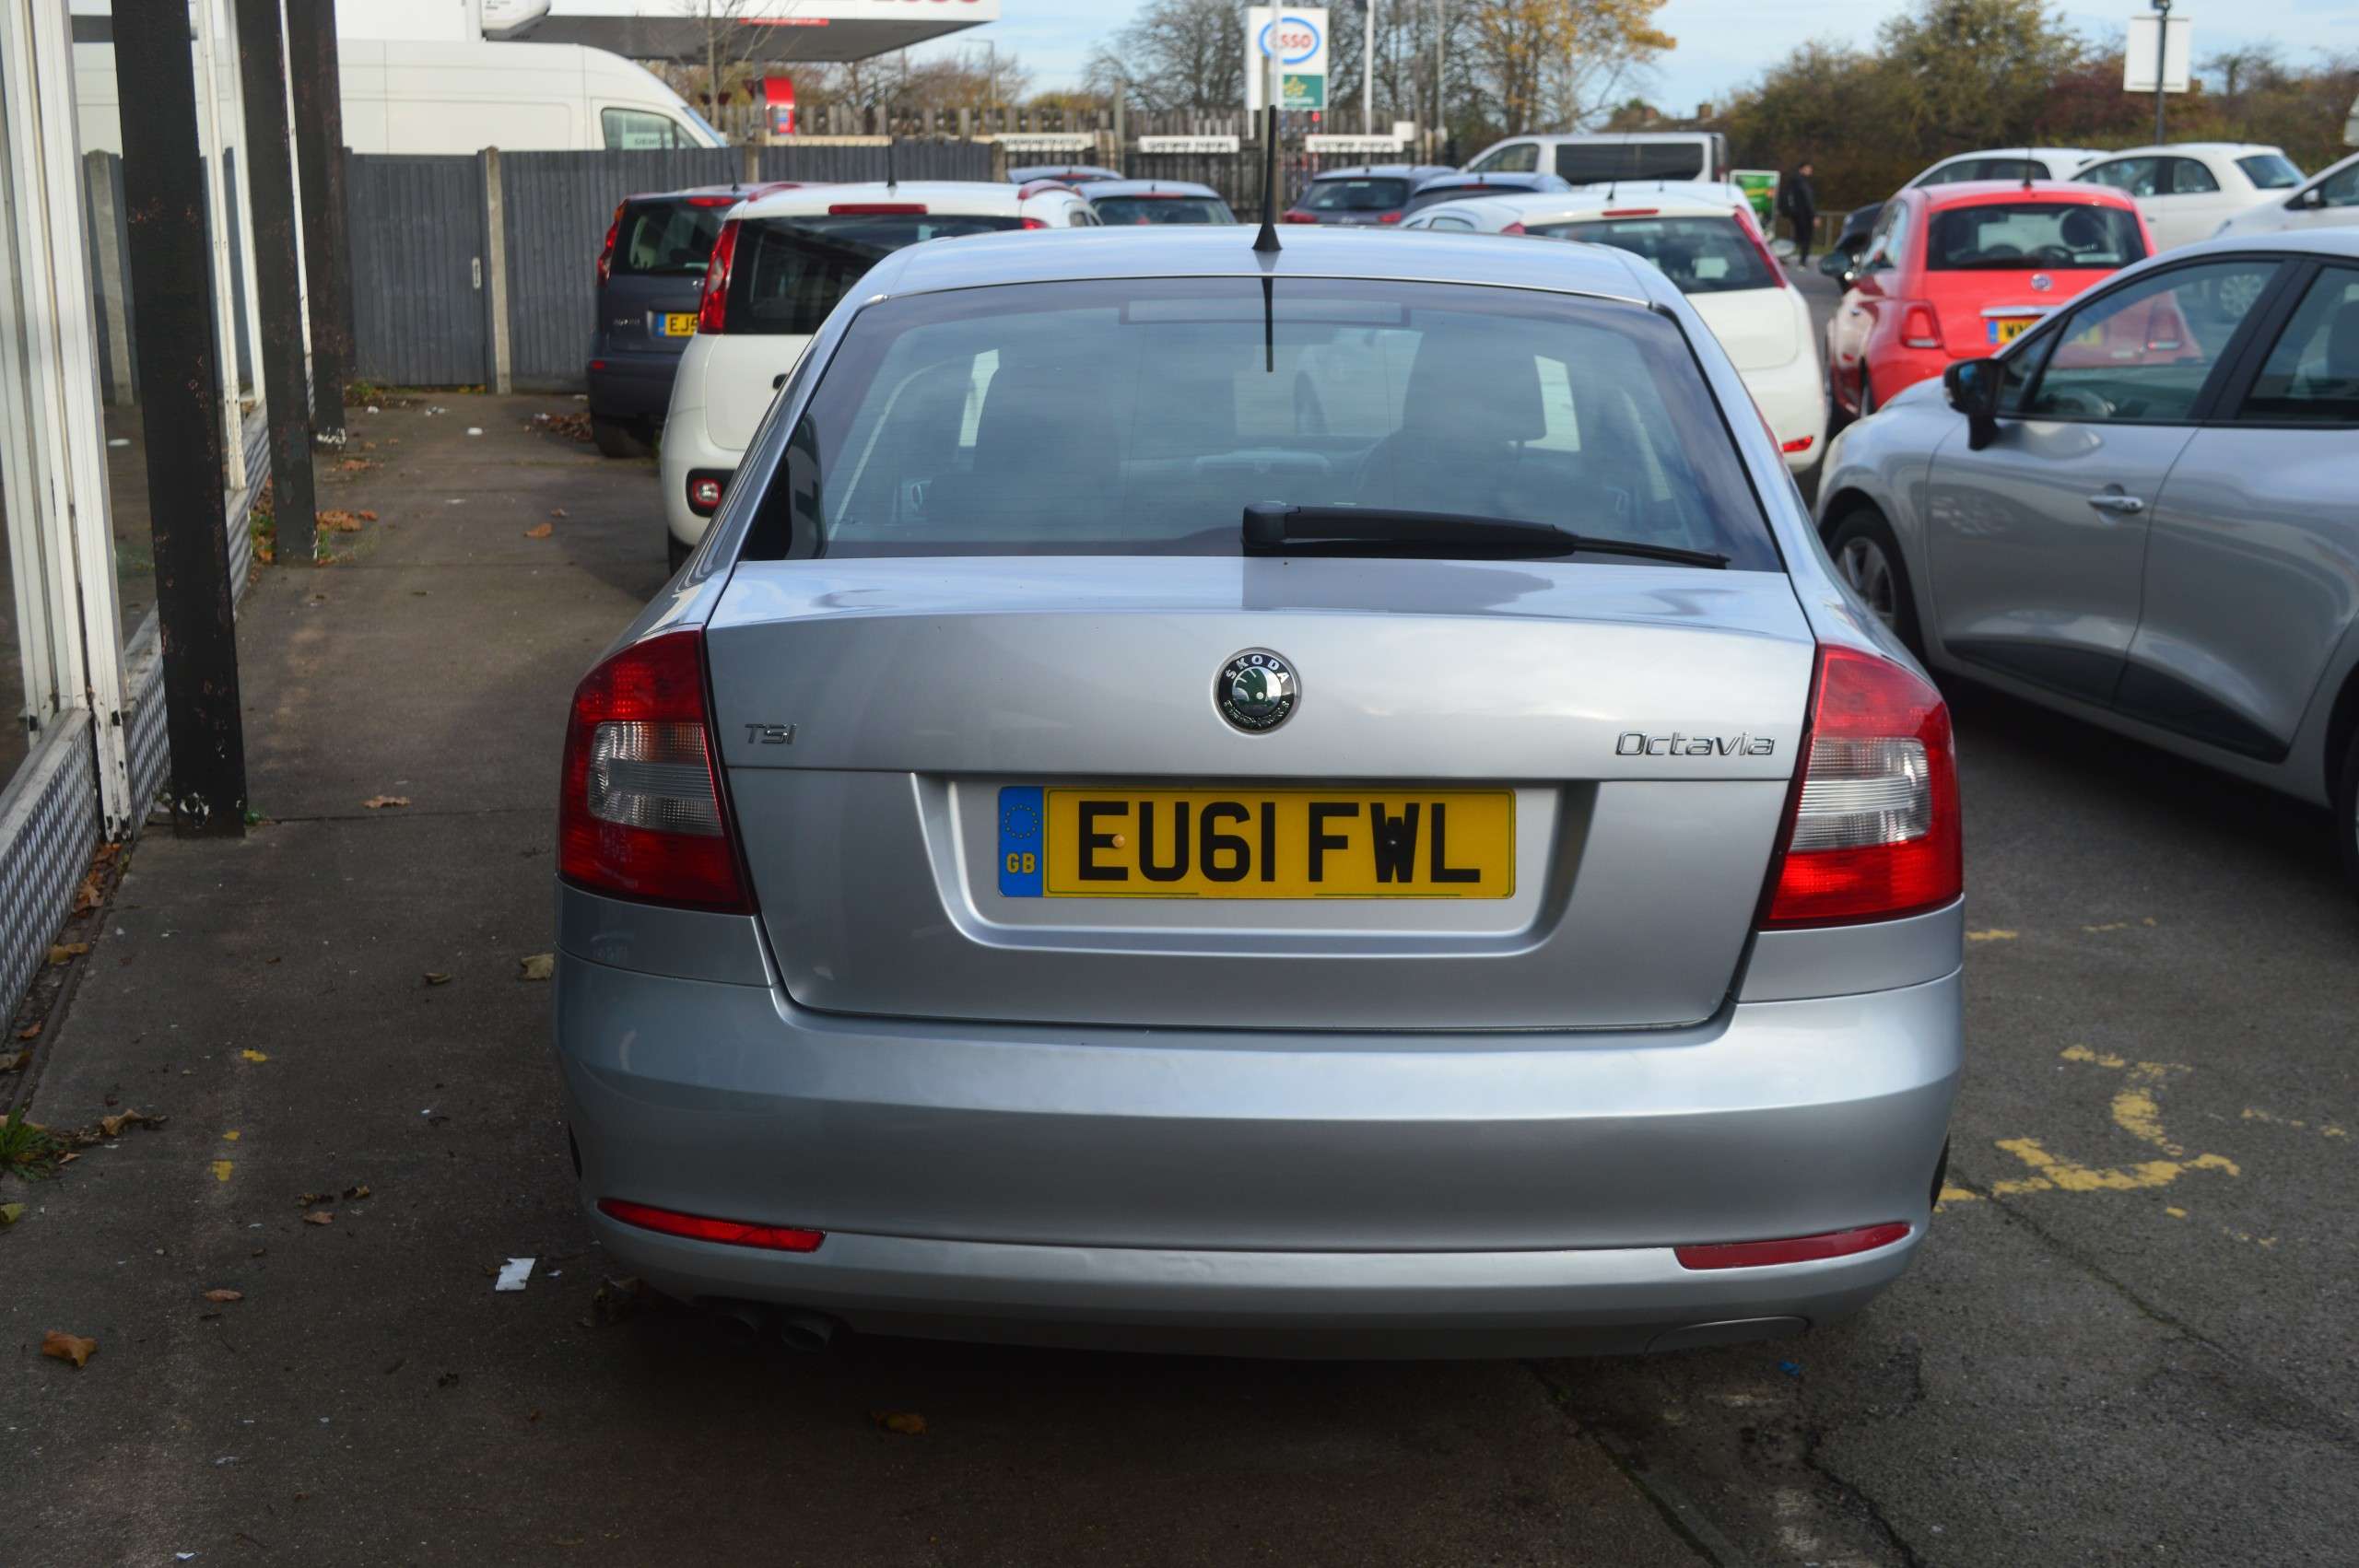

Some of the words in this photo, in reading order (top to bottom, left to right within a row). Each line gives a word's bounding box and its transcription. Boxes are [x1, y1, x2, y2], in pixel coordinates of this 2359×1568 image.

[1614, 730, 1777, 756] Octavia
[1078, 801, 1276, 883] EU61
[1309, 802, 1481, 883] FWL
[1006, 852, 1036, 873] GB
